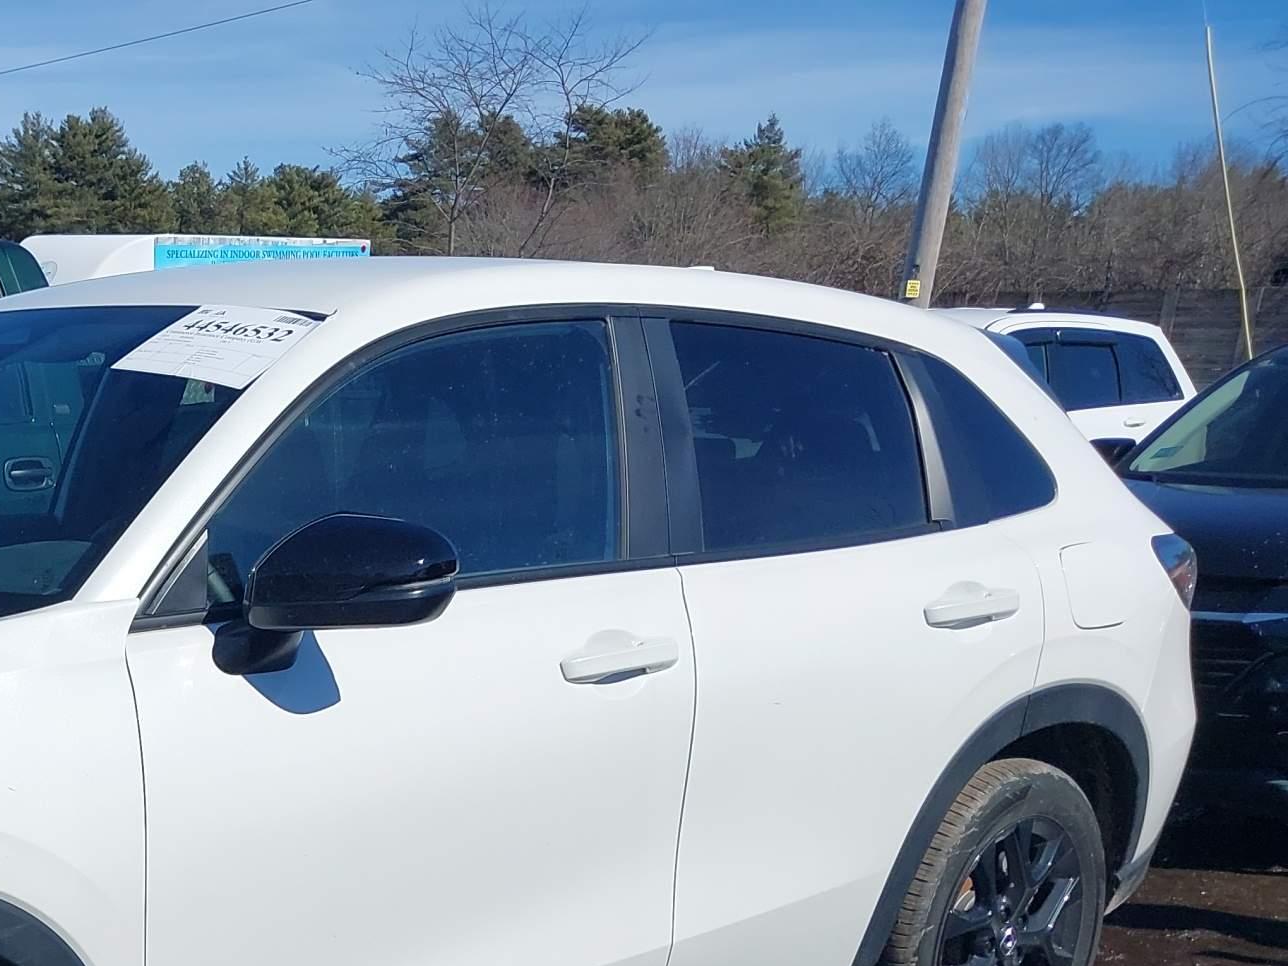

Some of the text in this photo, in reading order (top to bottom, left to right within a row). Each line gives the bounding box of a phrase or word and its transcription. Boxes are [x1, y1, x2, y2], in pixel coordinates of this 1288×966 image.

[166, 249, 219, 259] SPECIALIZING
[220, 249, 229, 259] IN
[230, 249, 261, 259] INDOOR
[262, 250, 301, 260] SWIMMING
[183, 319, 294, 342] 44546532
